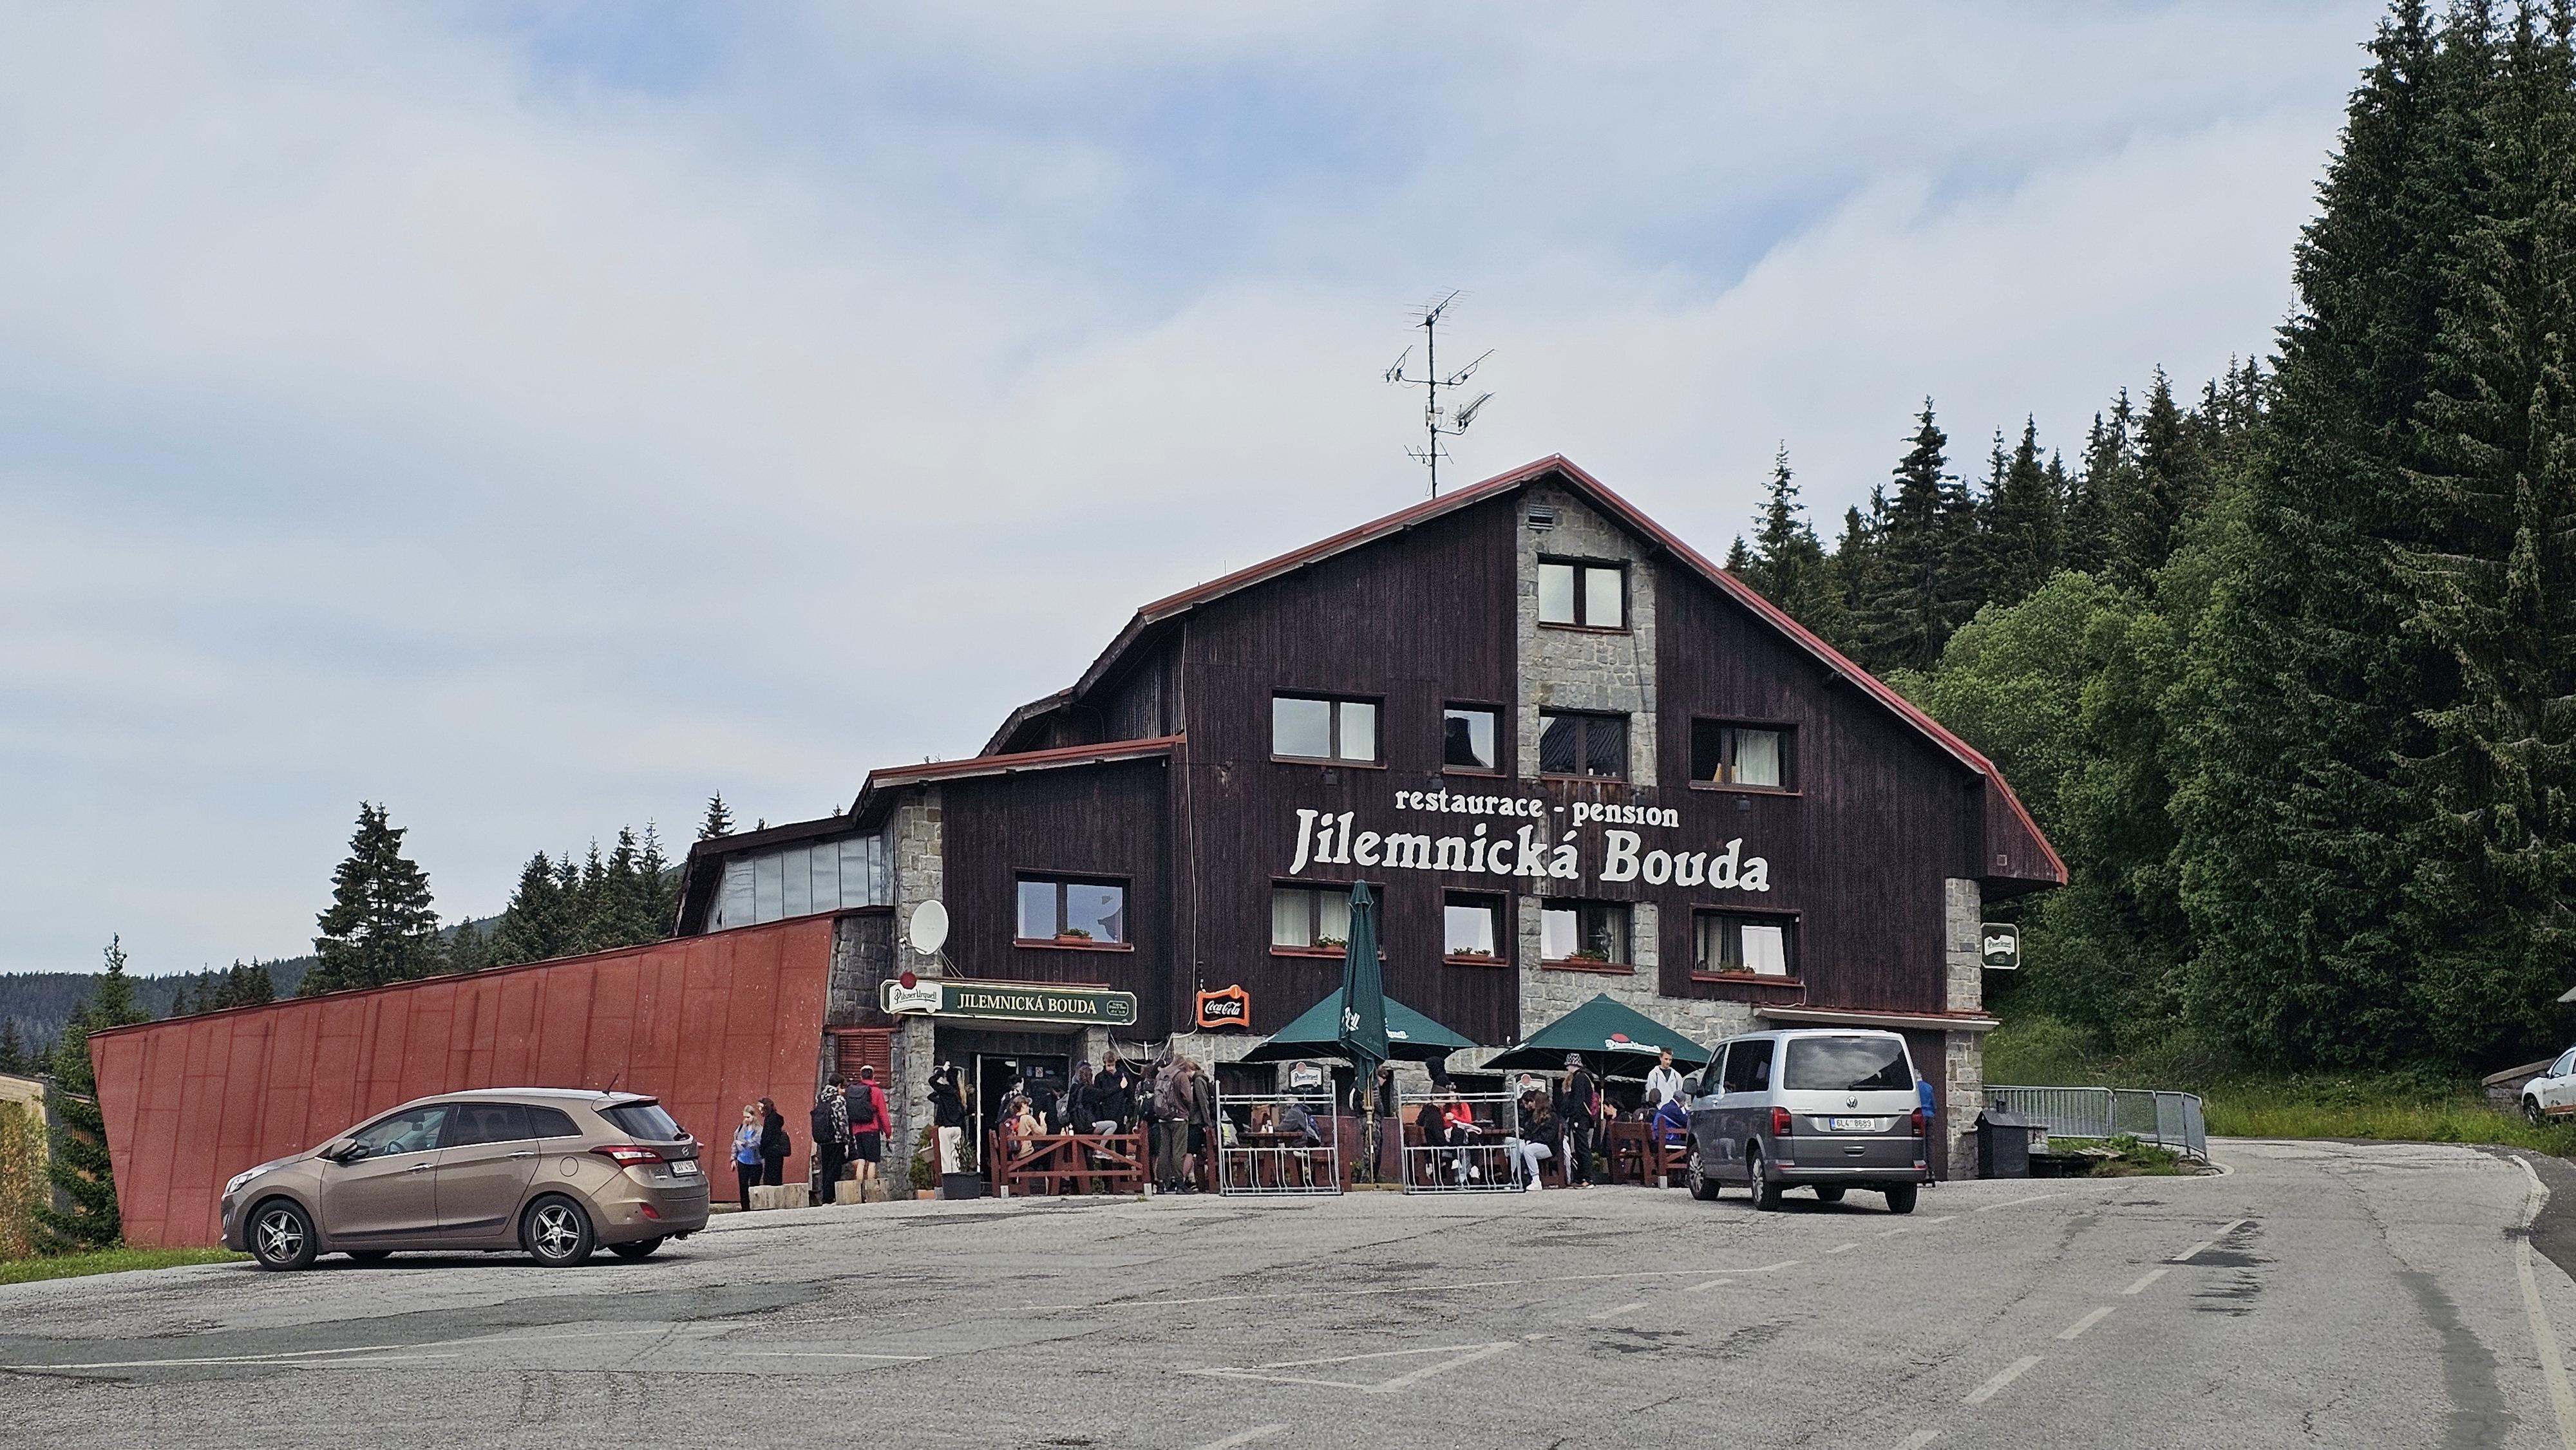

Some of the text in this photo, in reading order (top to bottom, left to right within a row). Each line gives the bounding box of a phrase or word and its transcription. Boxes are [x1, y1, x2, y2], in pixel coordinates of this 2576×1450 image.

[1395, 787, 1543, 817] restaurace
[1572, 801, 1680, 828] pension
[1289, 809, 1770, 892] Jilemnická Bouda
[957, 993, 1045, 1012] JILEMNICKÁ
[1048, 998, 1097, 1014] BOUDA
